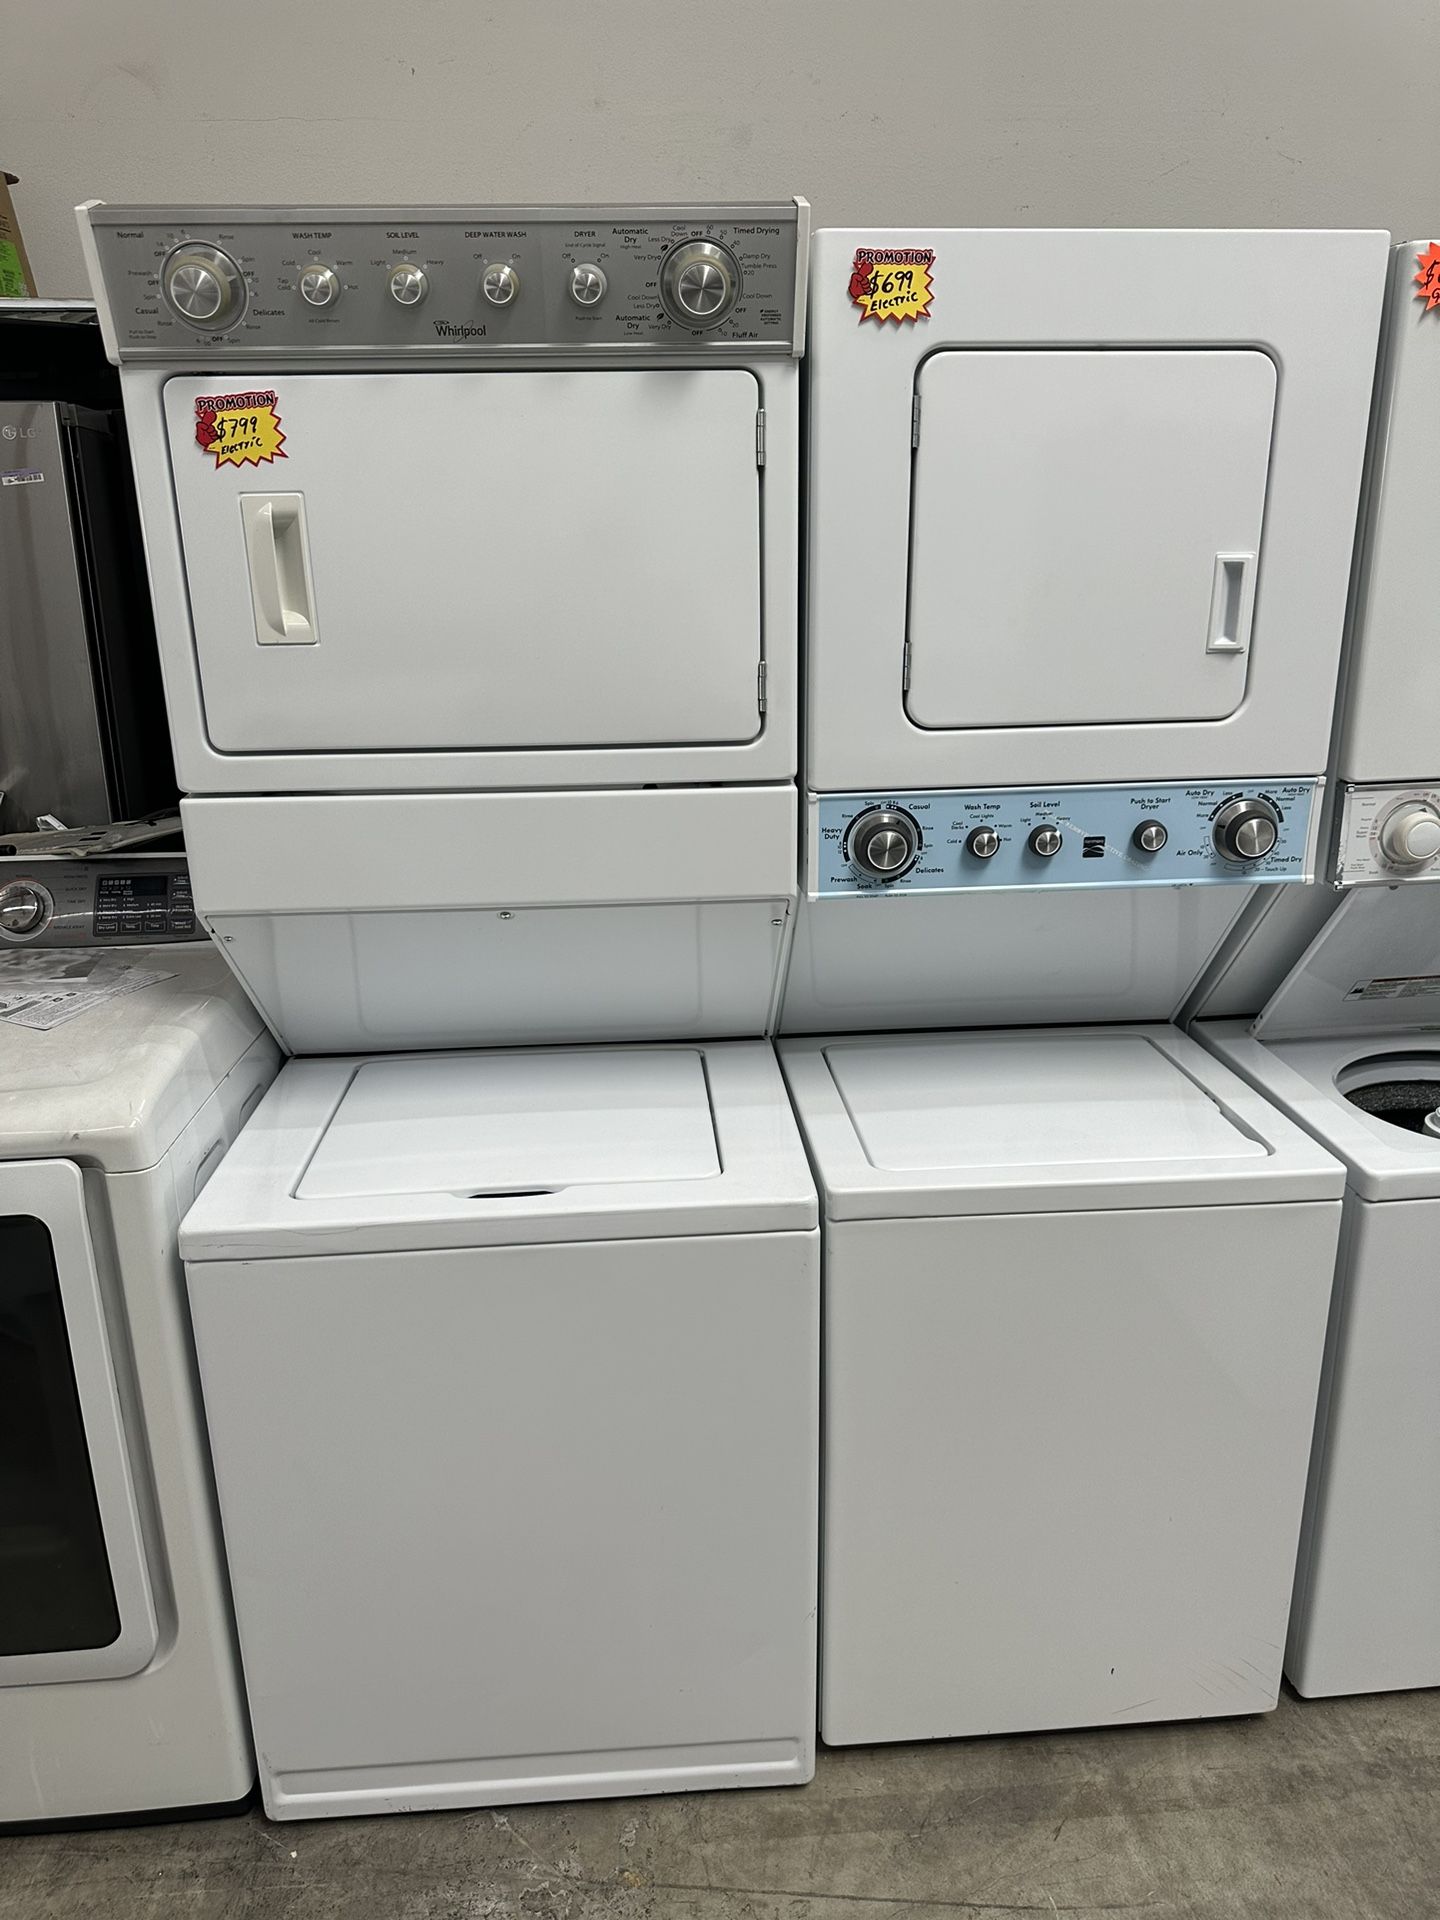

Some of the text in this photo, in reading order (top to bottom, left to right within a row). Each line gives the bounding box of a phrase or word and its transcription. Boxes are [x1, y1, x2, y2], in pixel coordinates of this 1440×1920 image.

[117, 231, 144, 239] Normal
[757, 227, 780, 235] Drying
[624, 236, 637, 244] Dry
[857, 250, 932, 264] PROMOTION
[864, 270, 913, 299] $699
[870, 291, 918, 311] Electric
[135, 307, 159, 315] Casual
[253, 309, 286, 317] Delicates
[627, 322, 639, 330] Dry
[435, 324, 486, 340] Whirlpool
[197, 393, 274, 411] PROMOTION
[20, 427, 36, 439] LG
[216, 416, 258, 442] $799
[1298, 786, 1310, 794] Dry
[1187, 849, 1203, 857] Only
[1290, 855, 1303, 863] Dry
